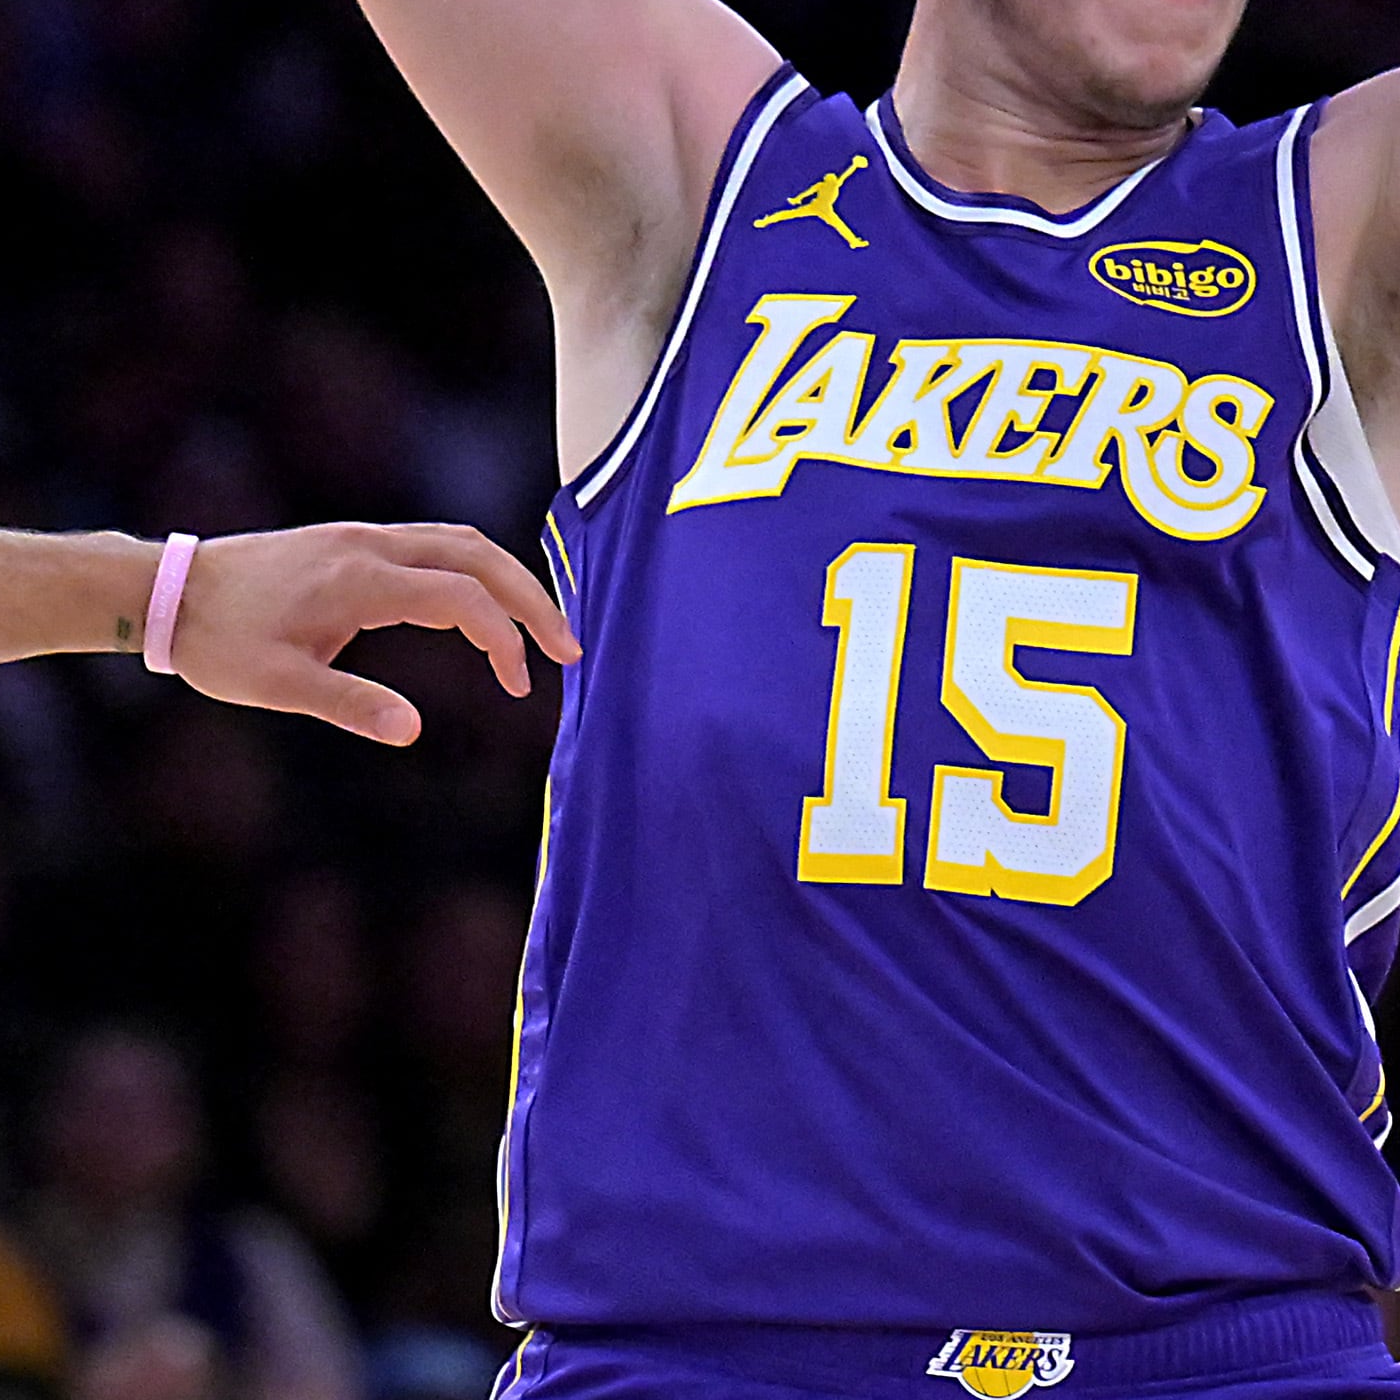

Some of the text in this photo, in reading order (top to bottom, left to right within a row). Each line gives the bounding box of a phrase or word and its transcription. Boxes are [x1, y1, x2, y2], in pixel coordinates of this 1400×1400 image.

[1103, 258, 1245, 298] bibigo
[666, 292, 1275, 542] LAKERS
[796, 542, 1139, 907] 15
[942, 1332, 1063, 1381] LAKERS
